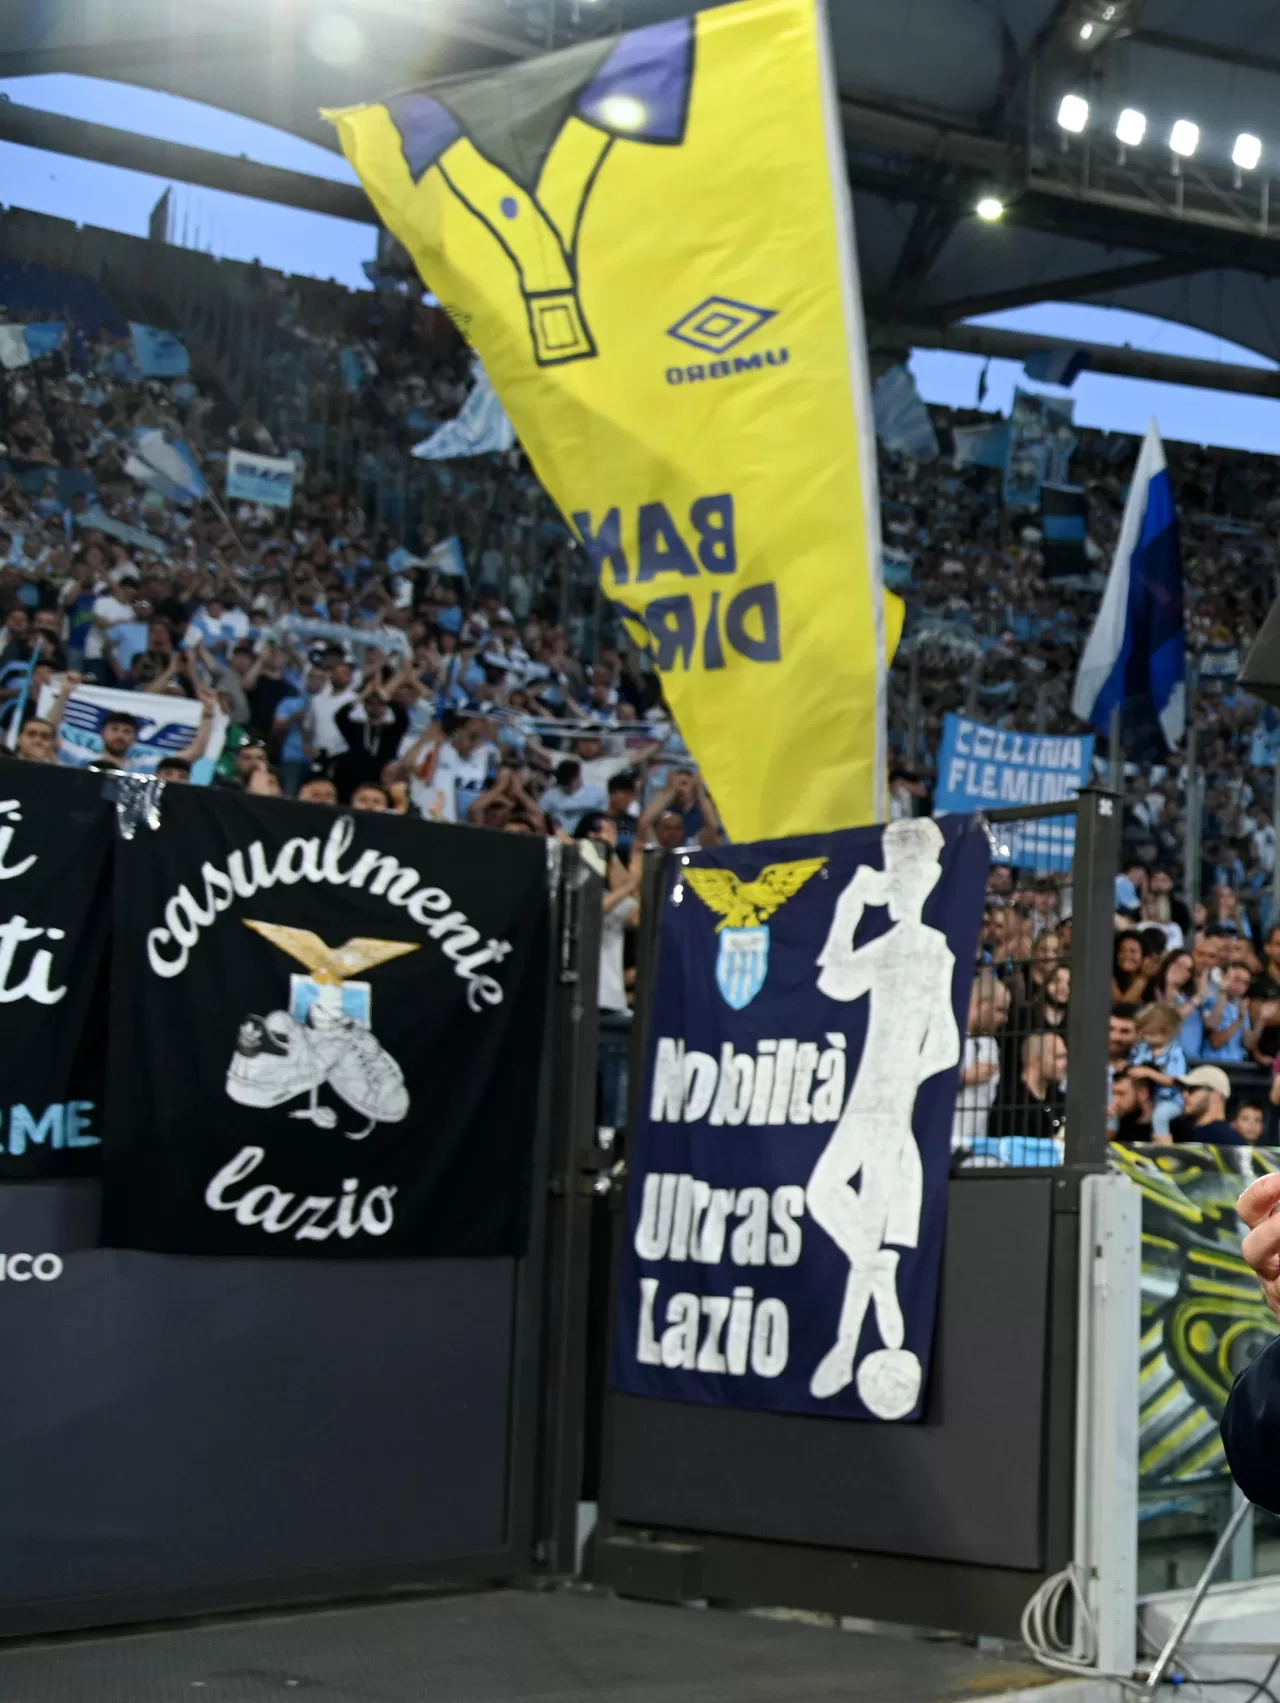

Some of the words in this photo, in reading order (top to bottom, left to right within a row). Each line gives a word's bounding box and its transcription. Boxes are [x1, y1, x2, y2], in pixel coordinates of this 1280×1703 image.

[955, 720, 1083, 770] COLLINA
[0, 1100, 102, 1156] ME
[636, 1277, 790, 1378] Lazio
